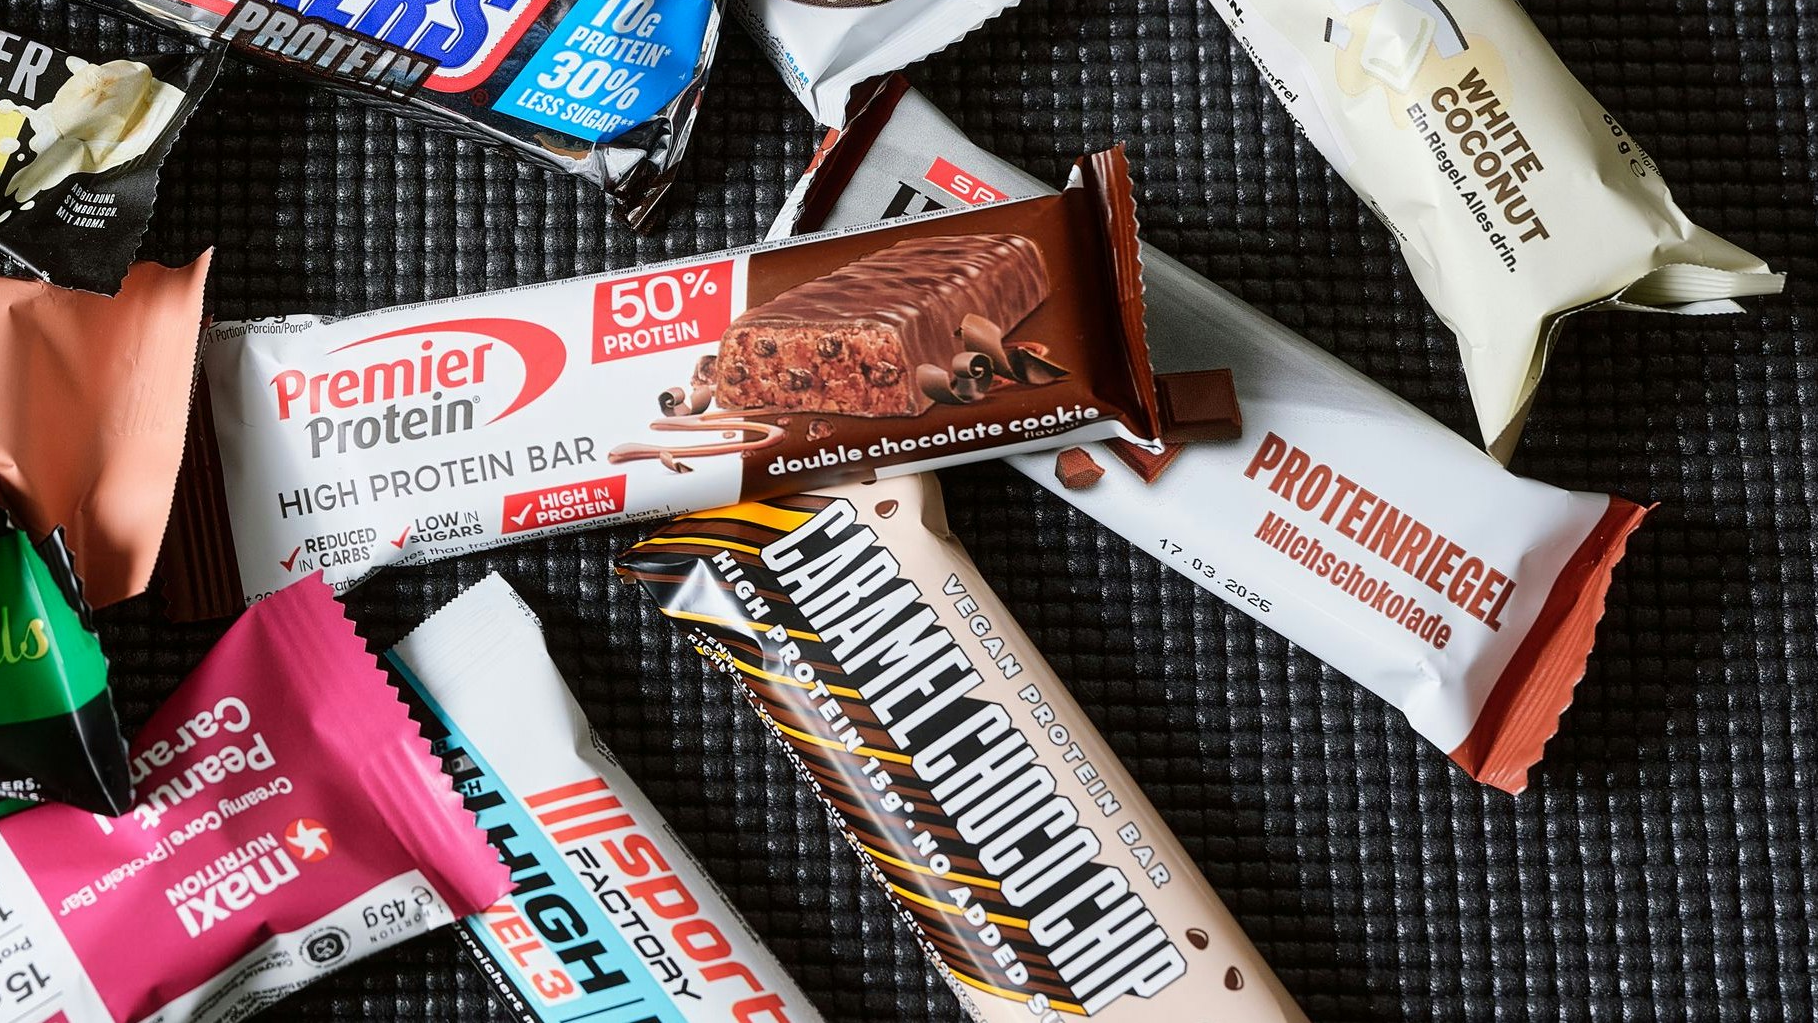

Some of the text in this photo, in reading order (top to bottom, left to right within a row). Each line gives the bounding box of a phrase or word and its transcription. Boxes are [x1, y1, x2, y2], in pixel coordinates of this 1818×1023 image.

[516, 83, 563, 116] LESS
[536, 45, 642, 113] 30%
[1426, 82, 1550, 251] COCONUT
[1453, 66, 1545, 183] WHITE
[1404, 103, 1523, 273] Ein Alles drin.
[602, 319, 699, 354] PROTEIN
[608, 268, 719, 331] 50%
[277, 437, 597, 520] HIGH BAR
[767, 402, 1099, 477] double chocolate cookie
[305, 527, 377, 555] REDUCED
[416, 513, 459, 535] LOW
[535, 498, 616, 524] PROTEIN
[539, 488, 587, 509] HIGH
[1243, 431, 1520, 631] PROTEINRIEGEL
[1252, 509, 1456, 651] Milchschokolade
[710, 548, 950, 878] HIGH PROTEIN NO
[757, 496, 1190, 1016] CARAMEL CHOCO CHIP
[941, 573, 1173, 890] VEGAN PROTEIN BAR
[129, 731, 276, 831] Peanut
[56, 806, 222, 915] Core Bar
[164, 831, 278, 906] NUTRITION
[173, 848, 302, 938] maxi
[564, 846, 702, 998] FACTORY
